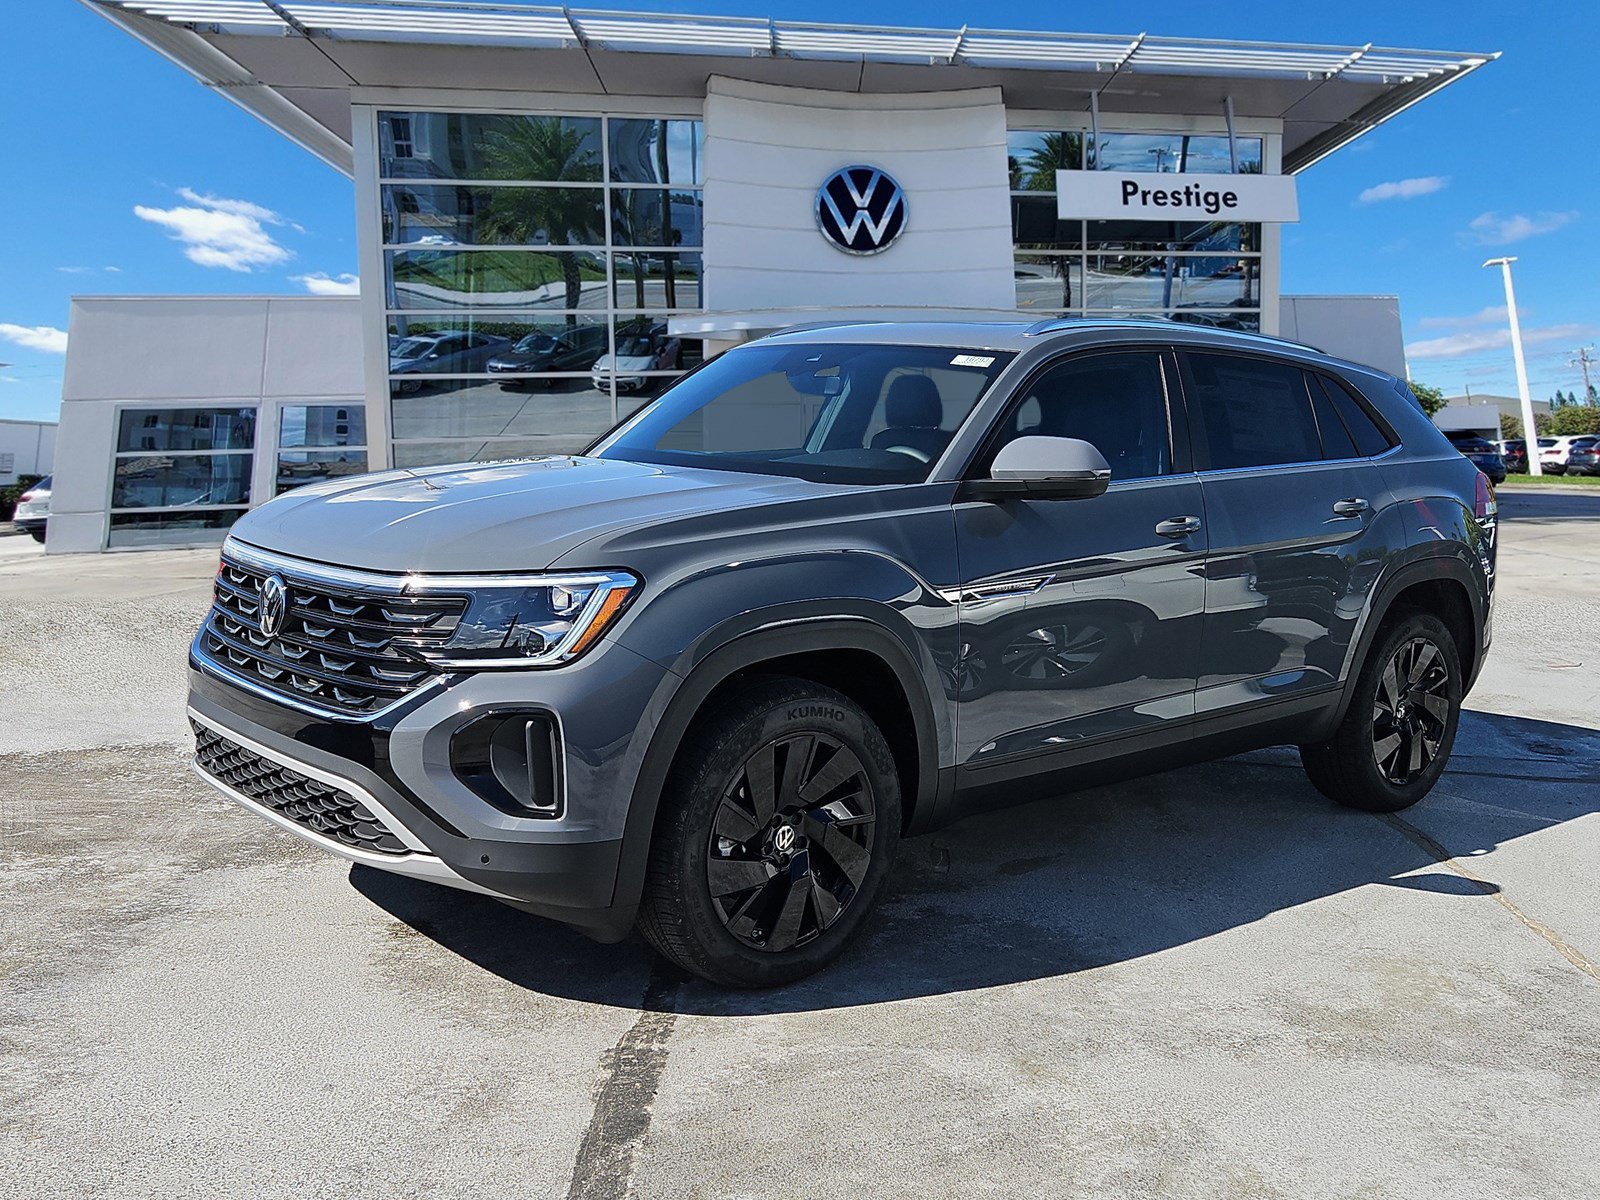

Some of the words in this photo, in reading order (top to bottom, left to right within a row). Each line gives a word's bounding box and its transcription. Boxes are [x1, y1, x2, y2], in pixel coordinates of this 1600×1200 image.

[818, 167, 904, 249] VW
[1121, 181, 1238, 214] Prestige
[788, 706, 845, 722] KUMHO
